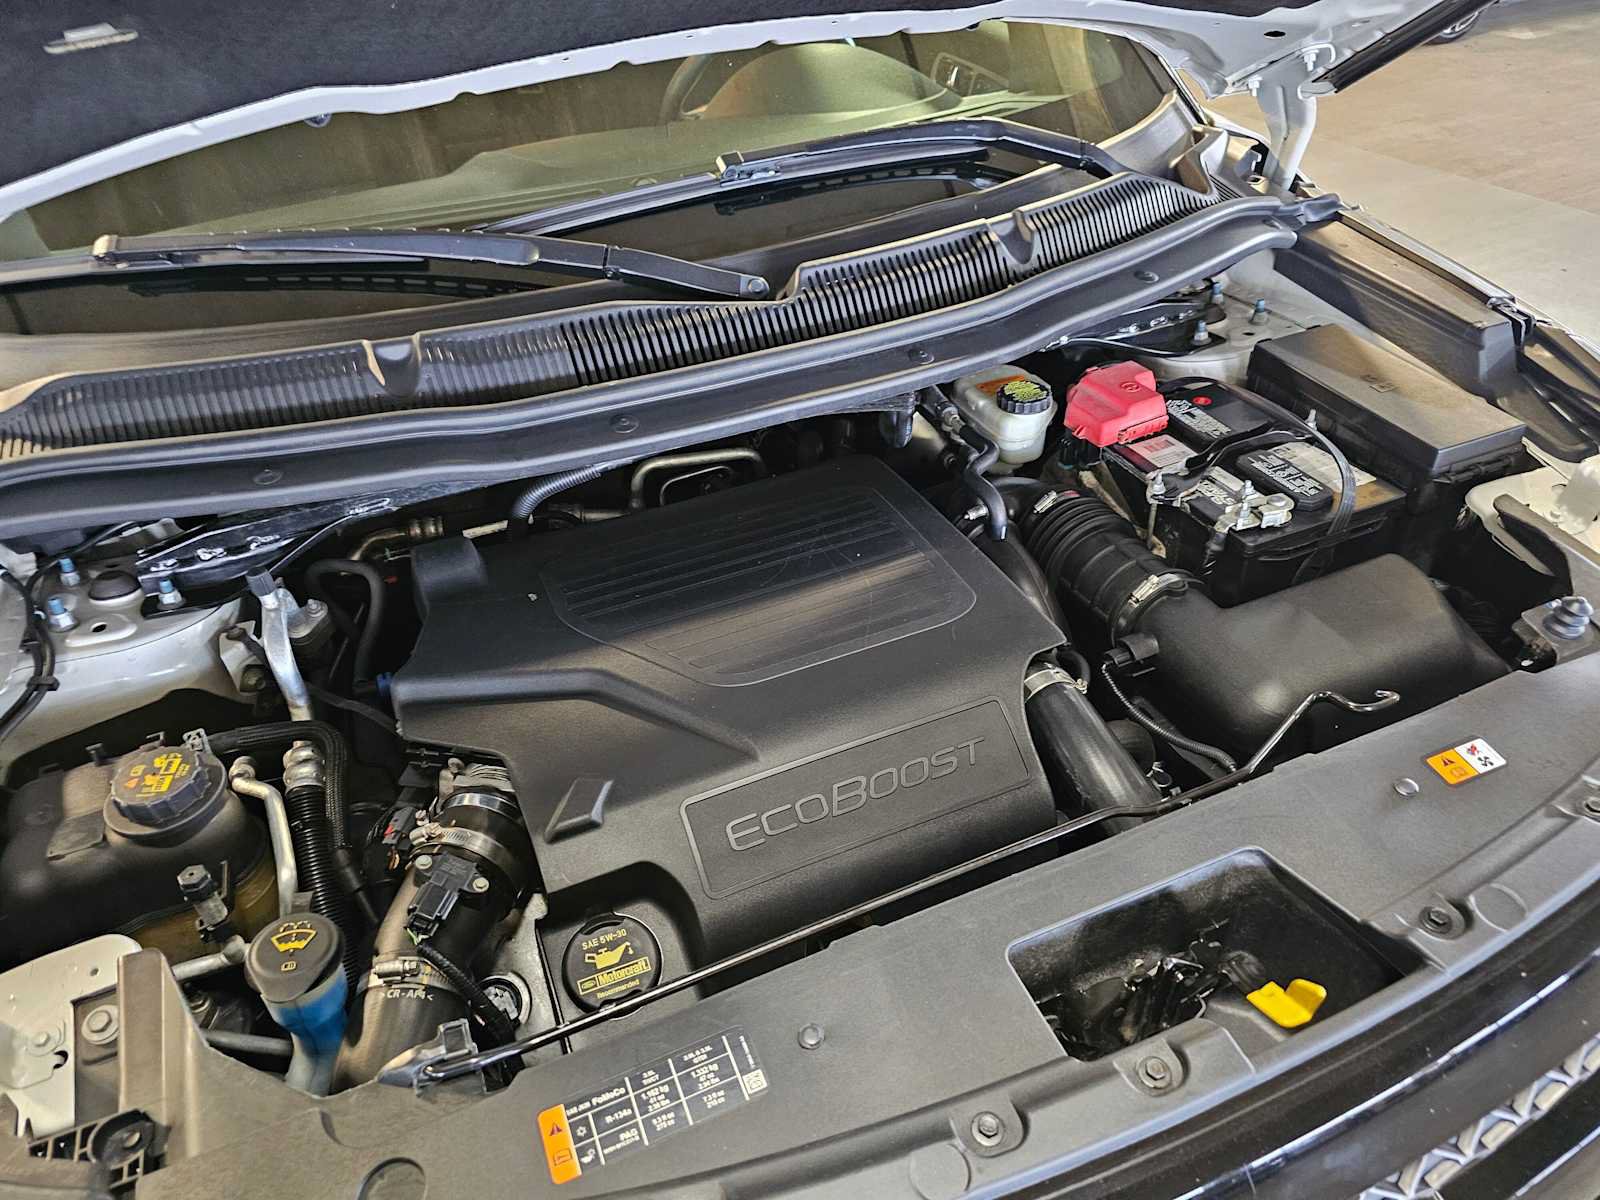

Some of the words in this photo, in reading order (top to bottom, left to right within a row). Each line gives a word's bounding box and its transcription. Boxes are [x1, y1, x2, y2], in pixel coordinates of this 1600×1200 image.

[725, 736, 985, 851] ECOBOOST
[582, 937, 600, 951] SAE
[600, 928, 627, 944] 5W-30
[598, 959, 648, 986] Motorcraft
